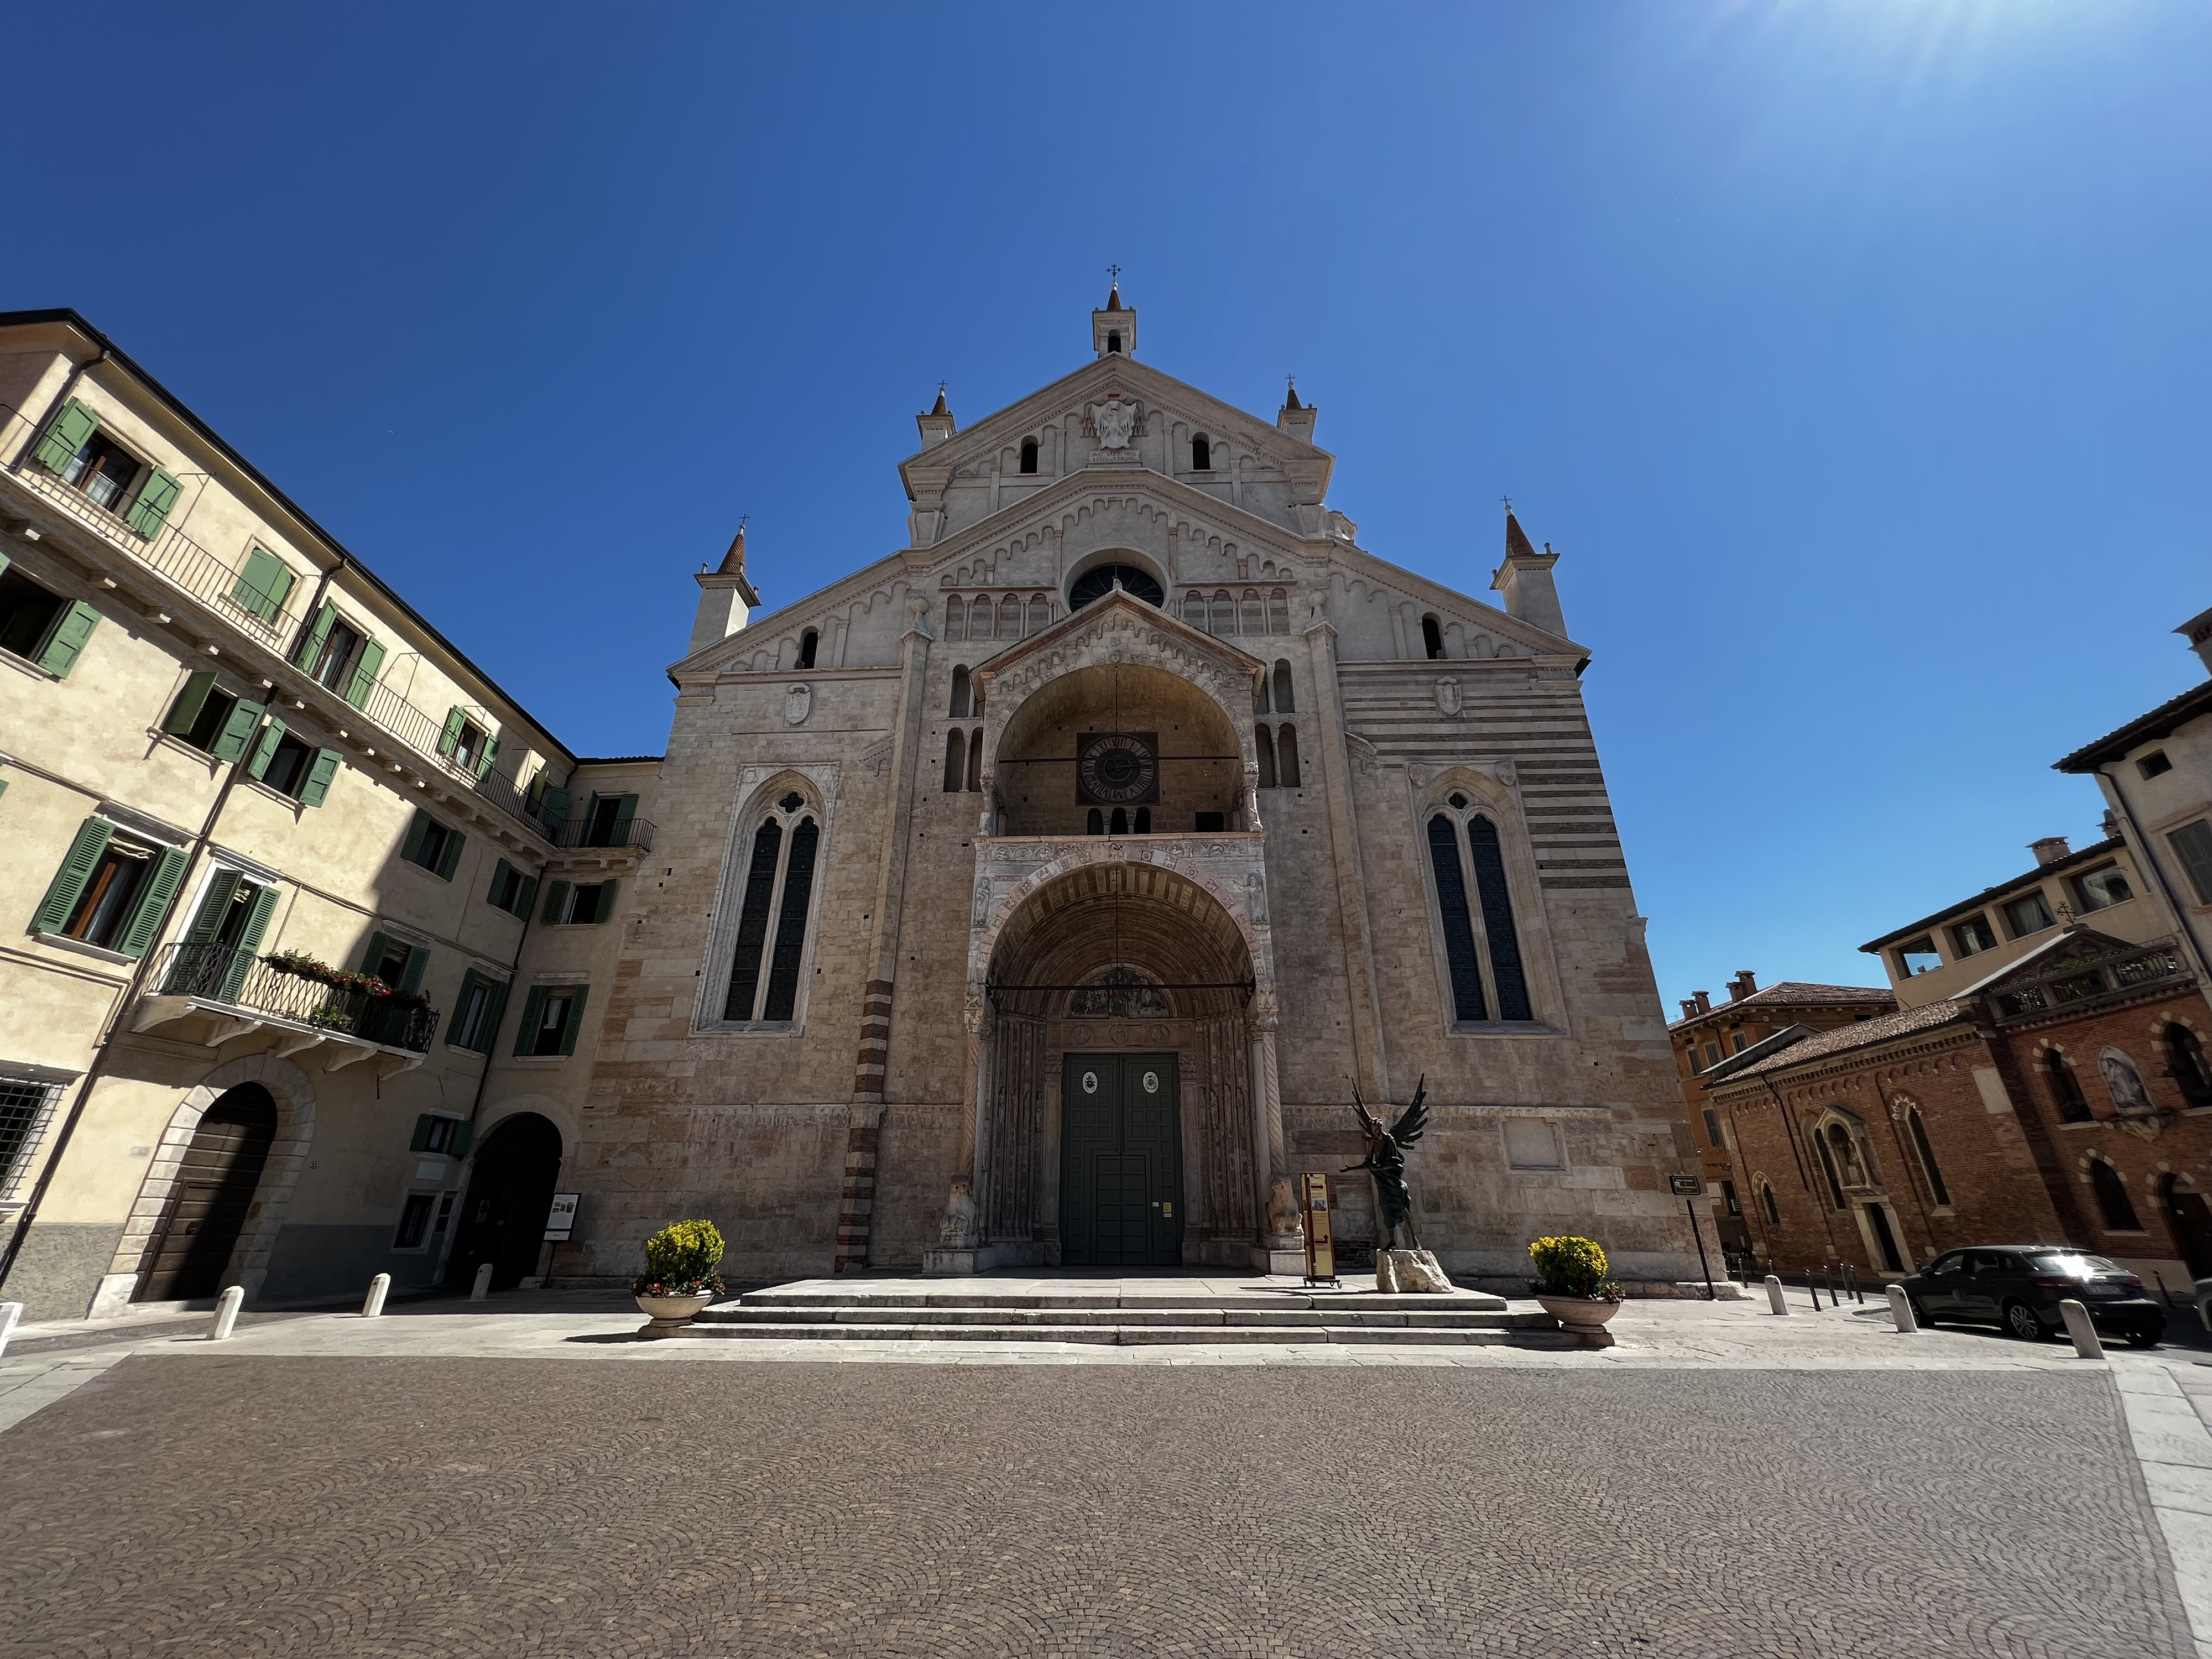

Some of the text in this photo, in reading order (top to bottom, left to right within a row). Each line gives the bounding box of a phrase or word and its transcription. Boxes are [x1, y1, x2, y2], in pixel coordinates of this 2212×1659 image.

[1098, 742, 1109, 752] XI
[1111, 738, 1124, 747] XII
[1083, 765, 1094, 774] IX
[1095, 787, 1108, 798] VII
[1113, 790, 1122, 799] VI
[1130, 787, 1138, 797] V
